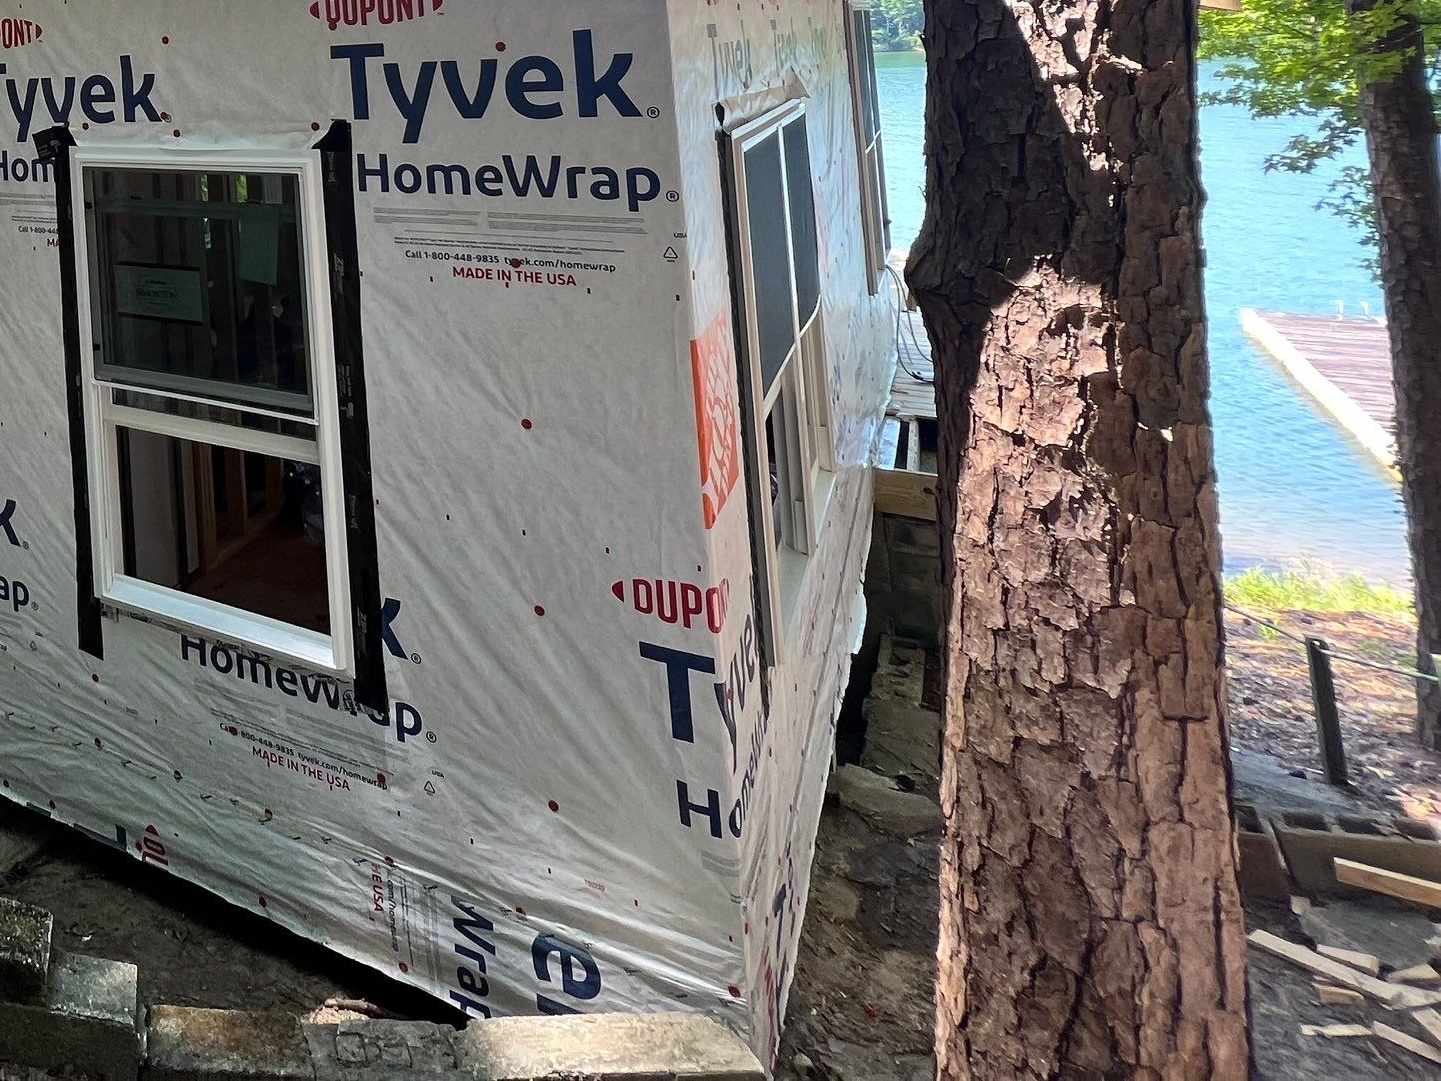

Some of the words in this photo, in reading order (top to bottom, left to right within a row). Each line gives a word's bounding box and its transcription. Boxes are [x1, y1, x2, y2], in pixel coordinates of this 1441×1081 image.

[330, 29, 644, 144] Tyvek
[357, 153, 661, 213] HomeWrap
[405, 250, 422, 260] Call
[424, 251, 500, 264] 1-800-448-9835
[504, 256, 616, 273] tyek.com/homewrap
[452, 266, 493, 280] MADE
[497, 269, 511, 281] IN
[516, 270, 543, 284] THE
[547, 273, 577, 286] USA
[180, 634, 422, 743] HomeWp
[238, 730, 295, 757] -800-448-9835
[252, 745, 285, 767] MADE
[288, 759, 299, 772] IN
[302, 765, 323, 782] THE
[326, 771, 351, 791] USA
[372, 885, 384, 912] USA
